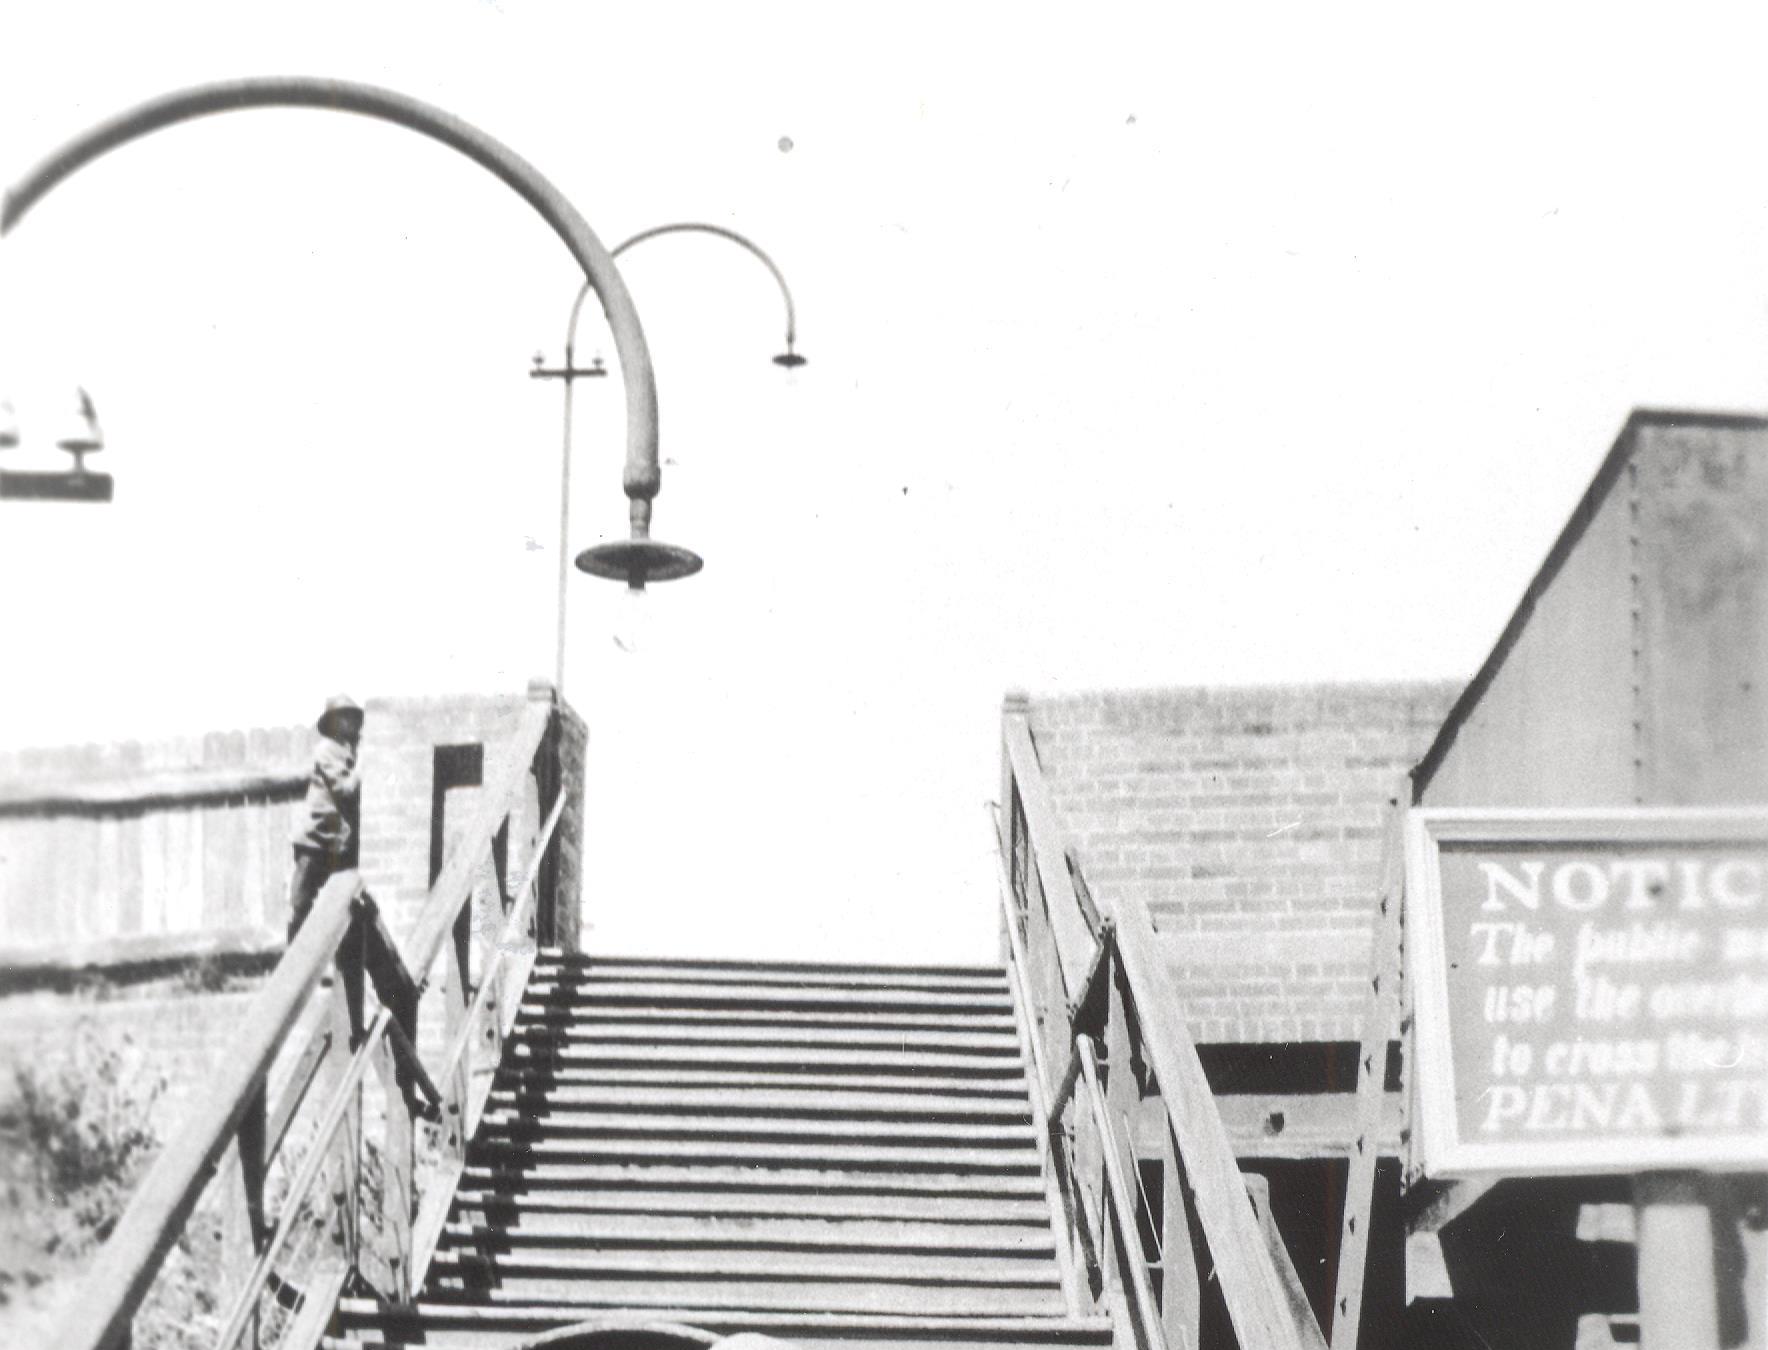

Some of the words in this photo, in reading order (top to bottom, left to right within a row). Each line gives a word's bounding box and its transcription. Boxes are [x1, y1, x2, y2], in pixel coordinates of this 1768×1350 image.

[1478, 859, 1764, 910] NOTIC
[1470, 920, 1555, 966] The
[1484, 985, 1555, 1023] use
[1493, 1034, 1533, 1076] to
[1546, 1040, 1660, 1076] cross
[1481, 1081, 1767, 1131] PENALT
